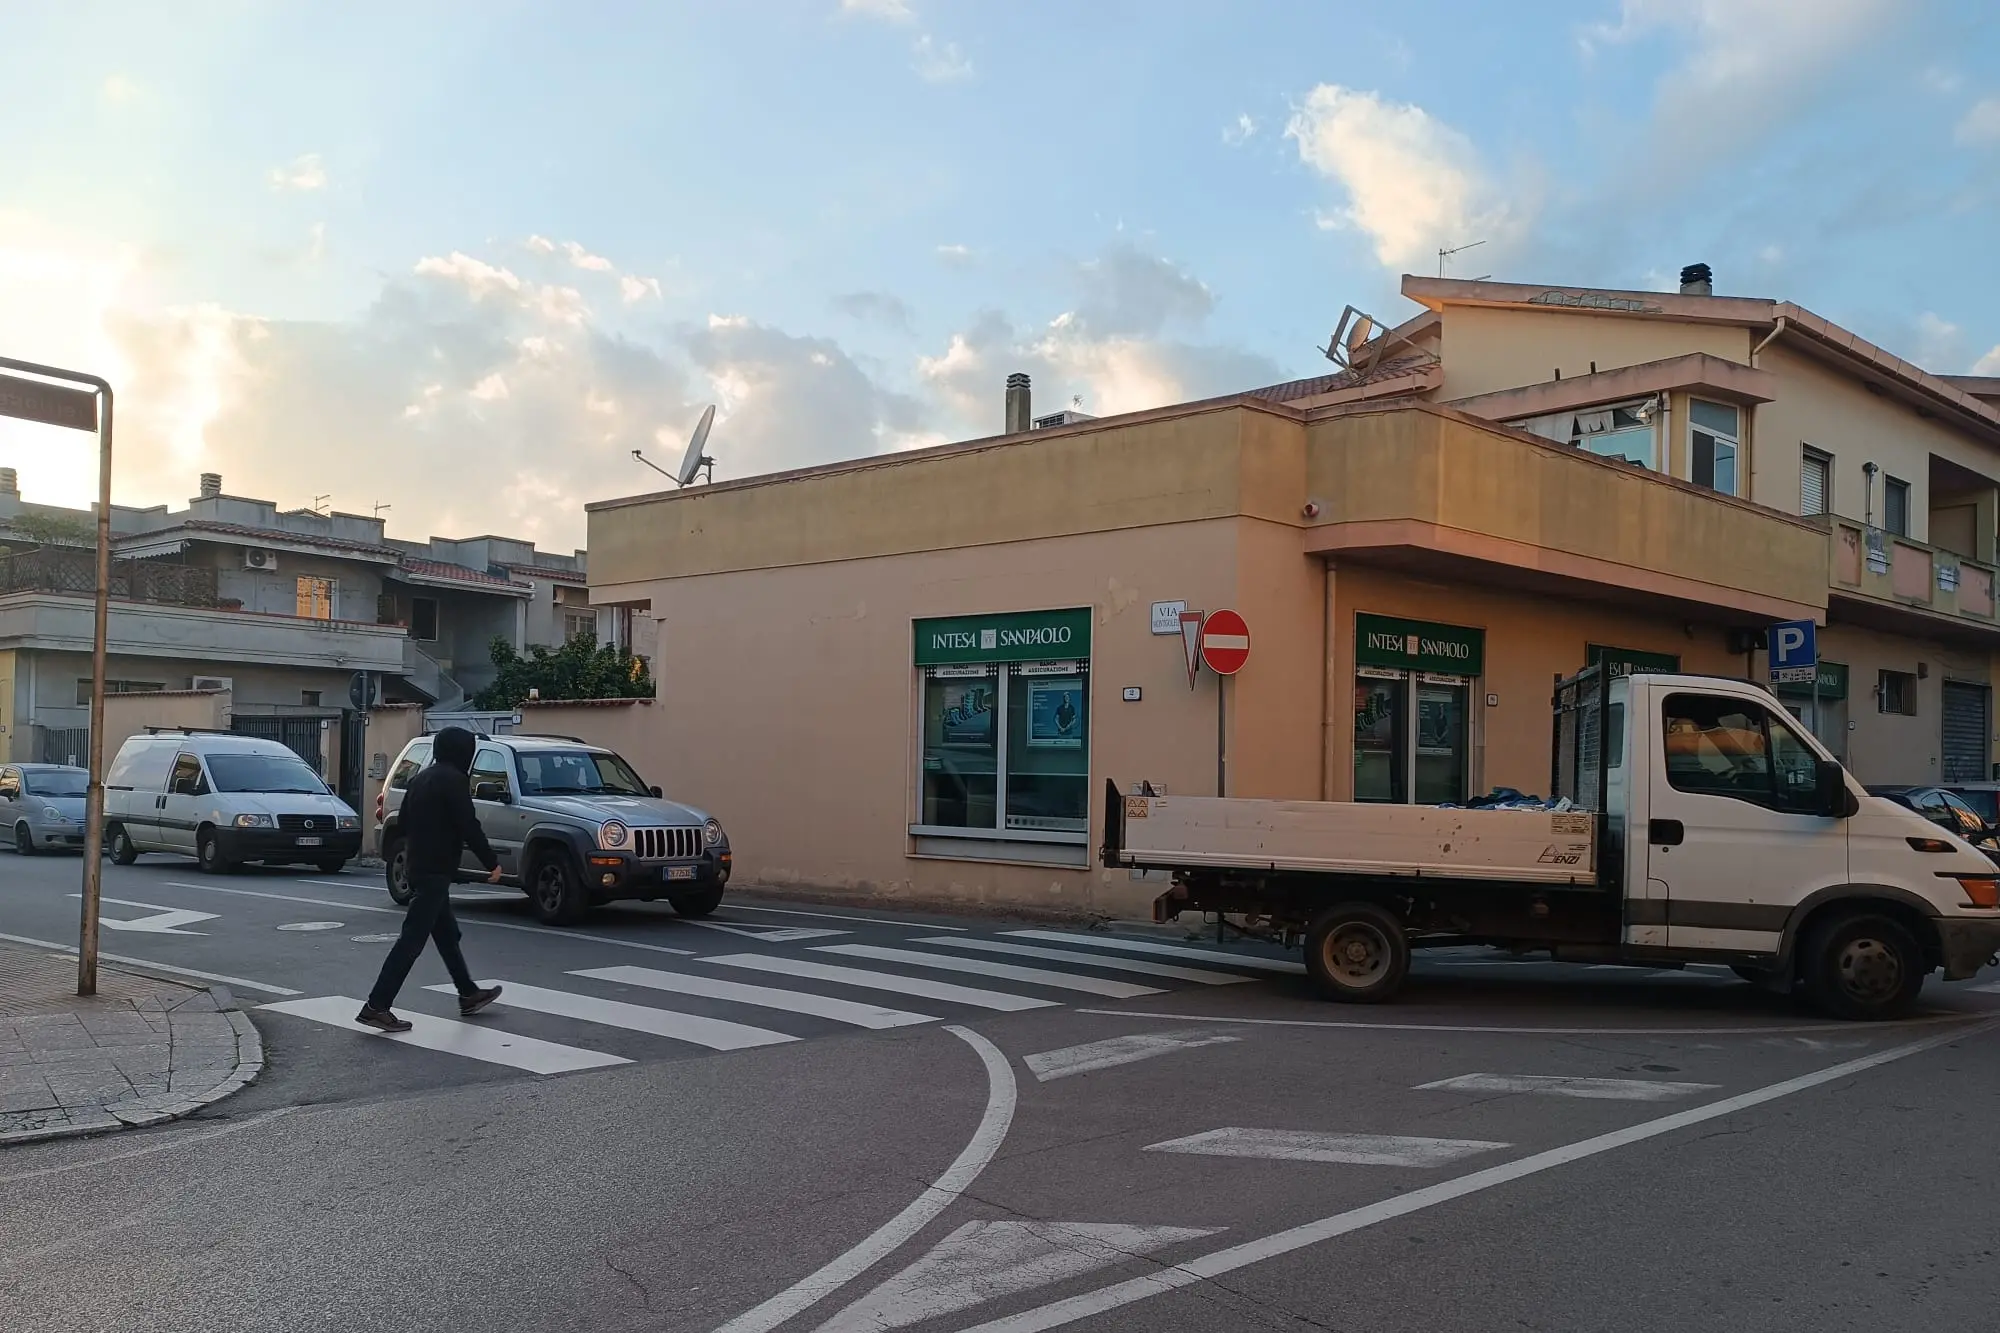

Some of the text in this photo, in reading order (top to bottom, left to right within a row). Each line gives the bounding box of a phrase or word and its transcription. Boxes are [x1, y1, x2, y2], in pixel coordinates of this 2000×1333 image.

[1159, 607, 1178, 617] VIA
[932, 626, 1072, 649] INTESA SANPAOLO
[1367, 632, 1469, 659] INTESA SANPAOLO
[1777, 627, 1805, 662] P
